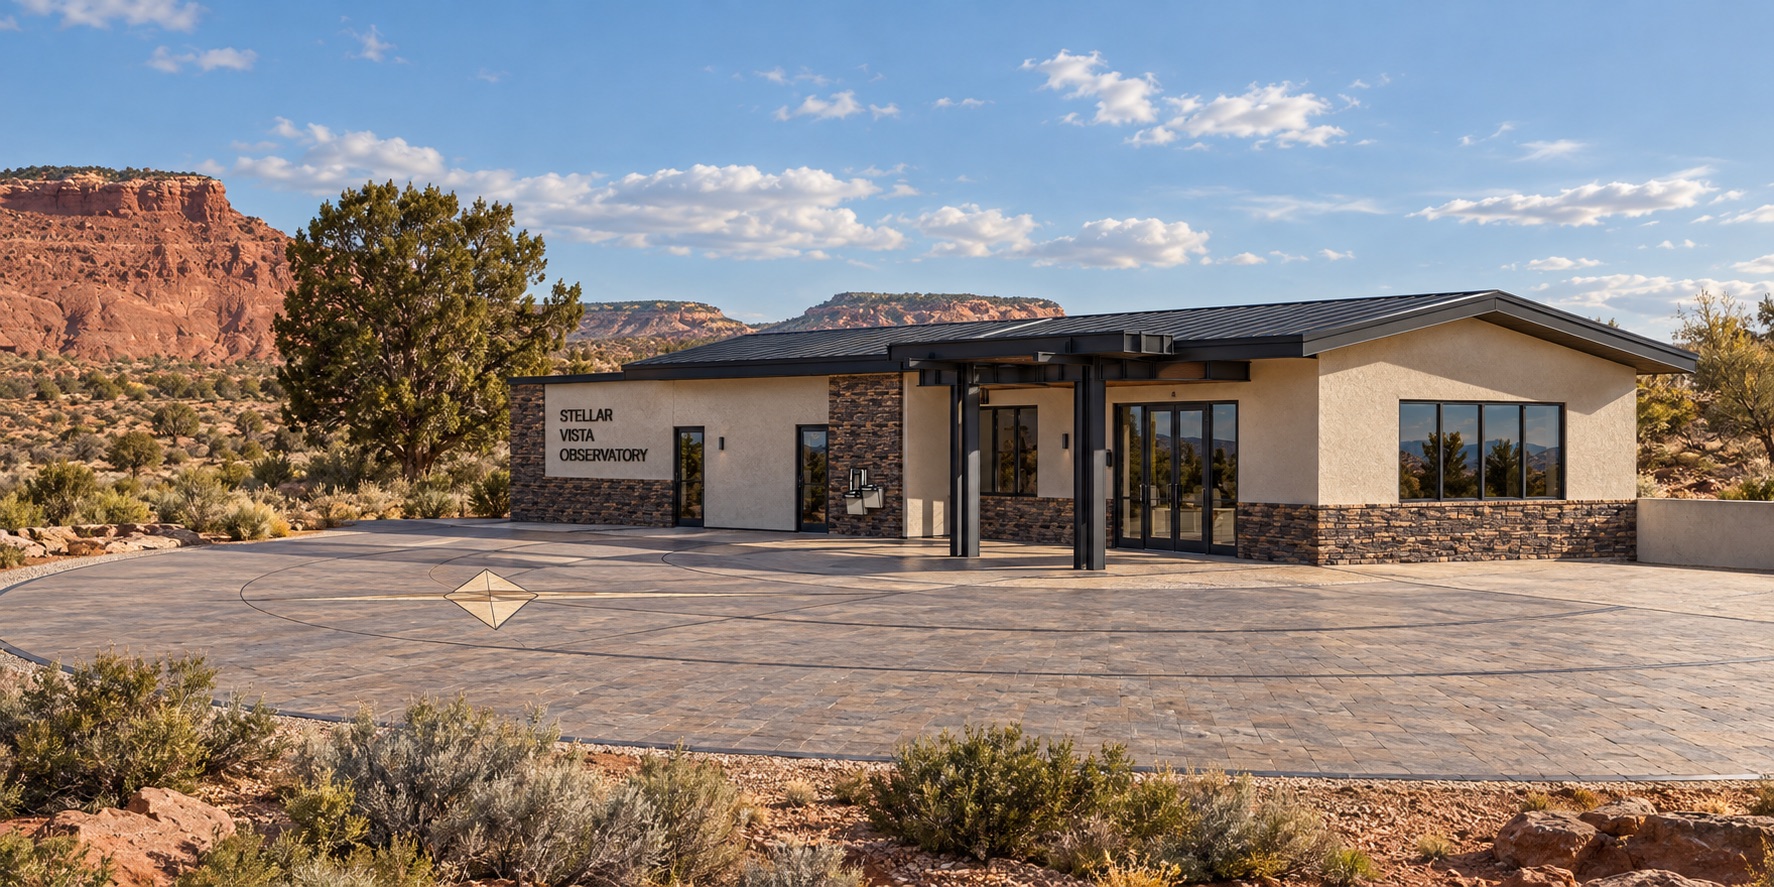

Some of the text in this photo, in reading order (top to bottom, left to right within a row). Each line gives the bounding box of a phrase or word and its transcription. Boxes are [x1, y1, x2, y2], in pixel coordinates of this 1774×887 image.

[560, 408, 613, 422] STELLAR
[559, 428, 595, 442] VISTA
[559, 448, 648, 462] OBSERVATORY
